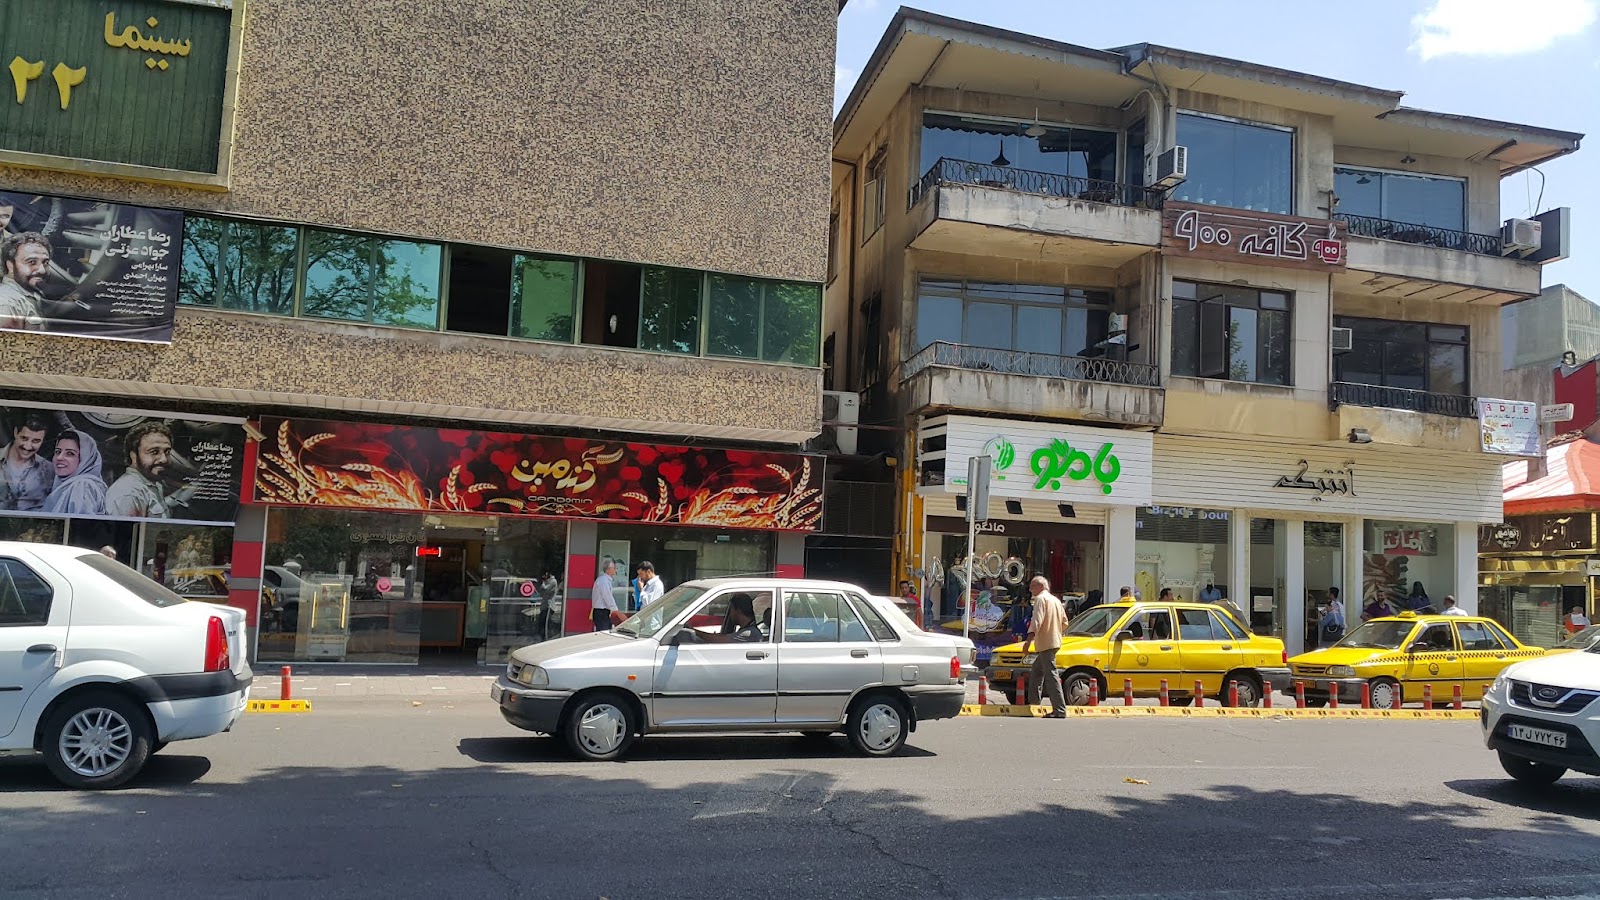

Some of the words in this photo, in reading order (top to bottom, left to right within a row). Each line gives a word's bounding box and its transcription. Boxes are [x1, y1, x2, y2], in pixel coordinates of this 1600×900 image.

[104, 11, 191, 71] سینما
[100, 224, 146, 242] عطاران
[147, 228, 170, 247] رضا
[1175, 210, 1232, 251] ۹۰۰
[1239, 222, 1308, 260] کافه
[105, 243, 138, 258] عزتی
[140, 245, 169, 261] جواد
[191, 442, 219, 452] عطاران
[220, 443, 234, 454] رضا
[194, 452, 215, 462] عزتی
[215, 454, 232, 463] جواد
[1030, 437, 1121, 495] بامبو
[974, 521, 1005, 535] مانگو
